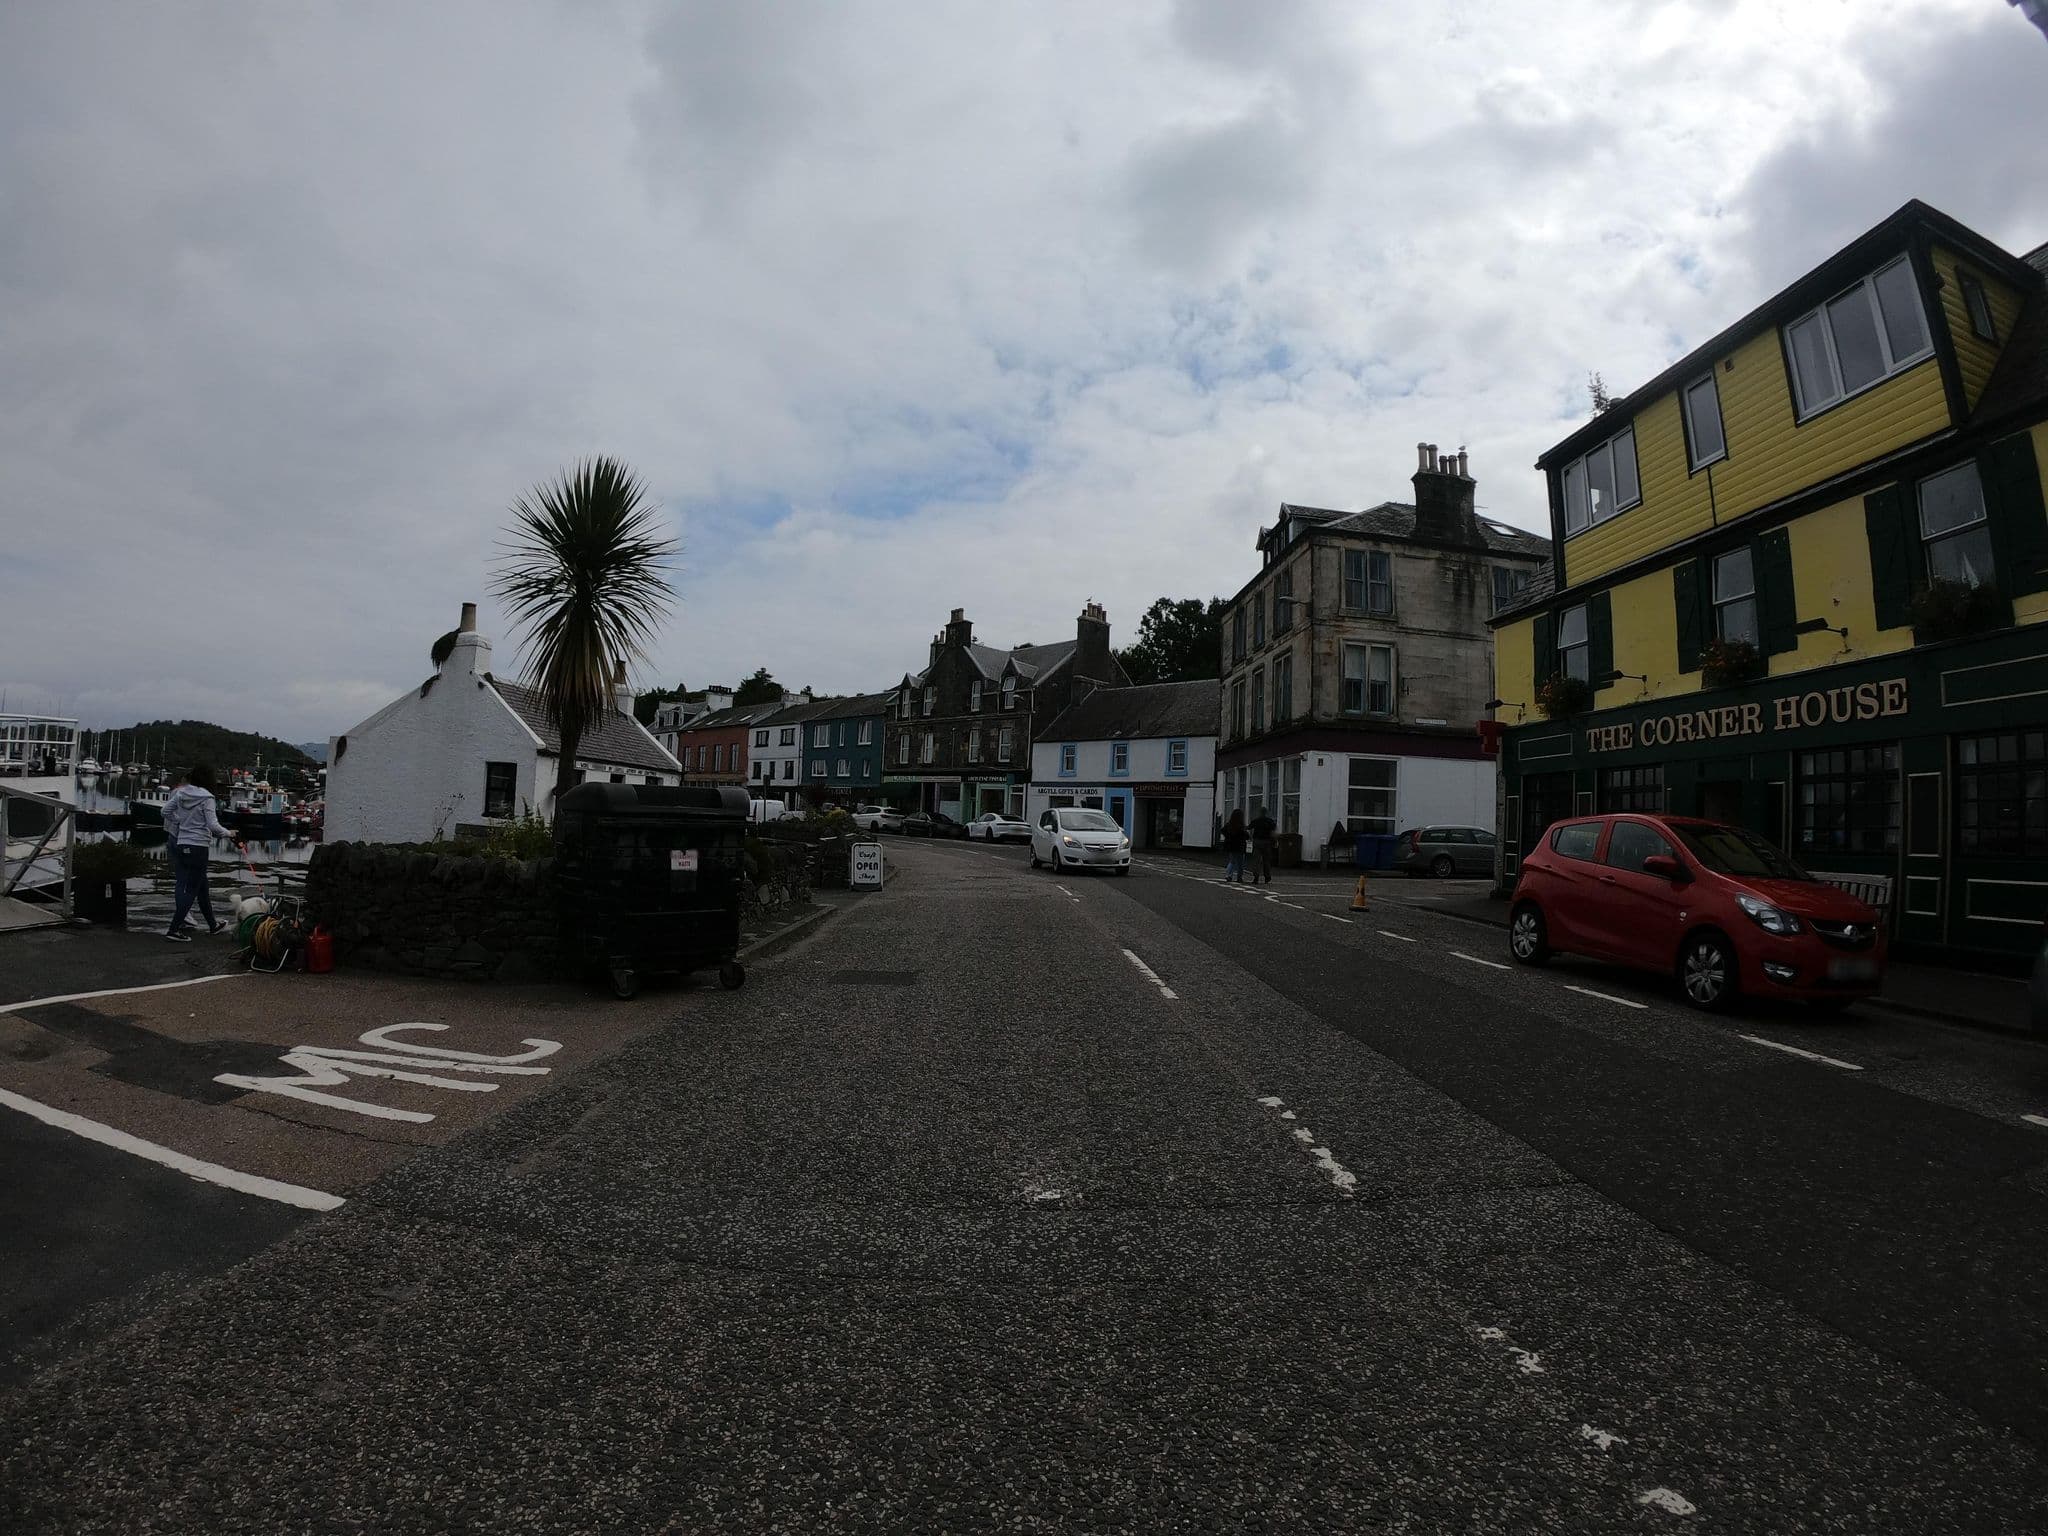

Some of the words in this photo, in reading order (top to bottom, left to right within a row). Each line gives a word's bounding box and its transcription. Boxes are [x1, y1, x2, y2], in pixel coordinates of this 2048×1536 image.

[1586, 722, 1633, 752] THE
[1640, 703, 1763, 747] CORNER
[1773, 677, 1908, 731] HOUSE
[856, 862, 878, 870] OPEN
